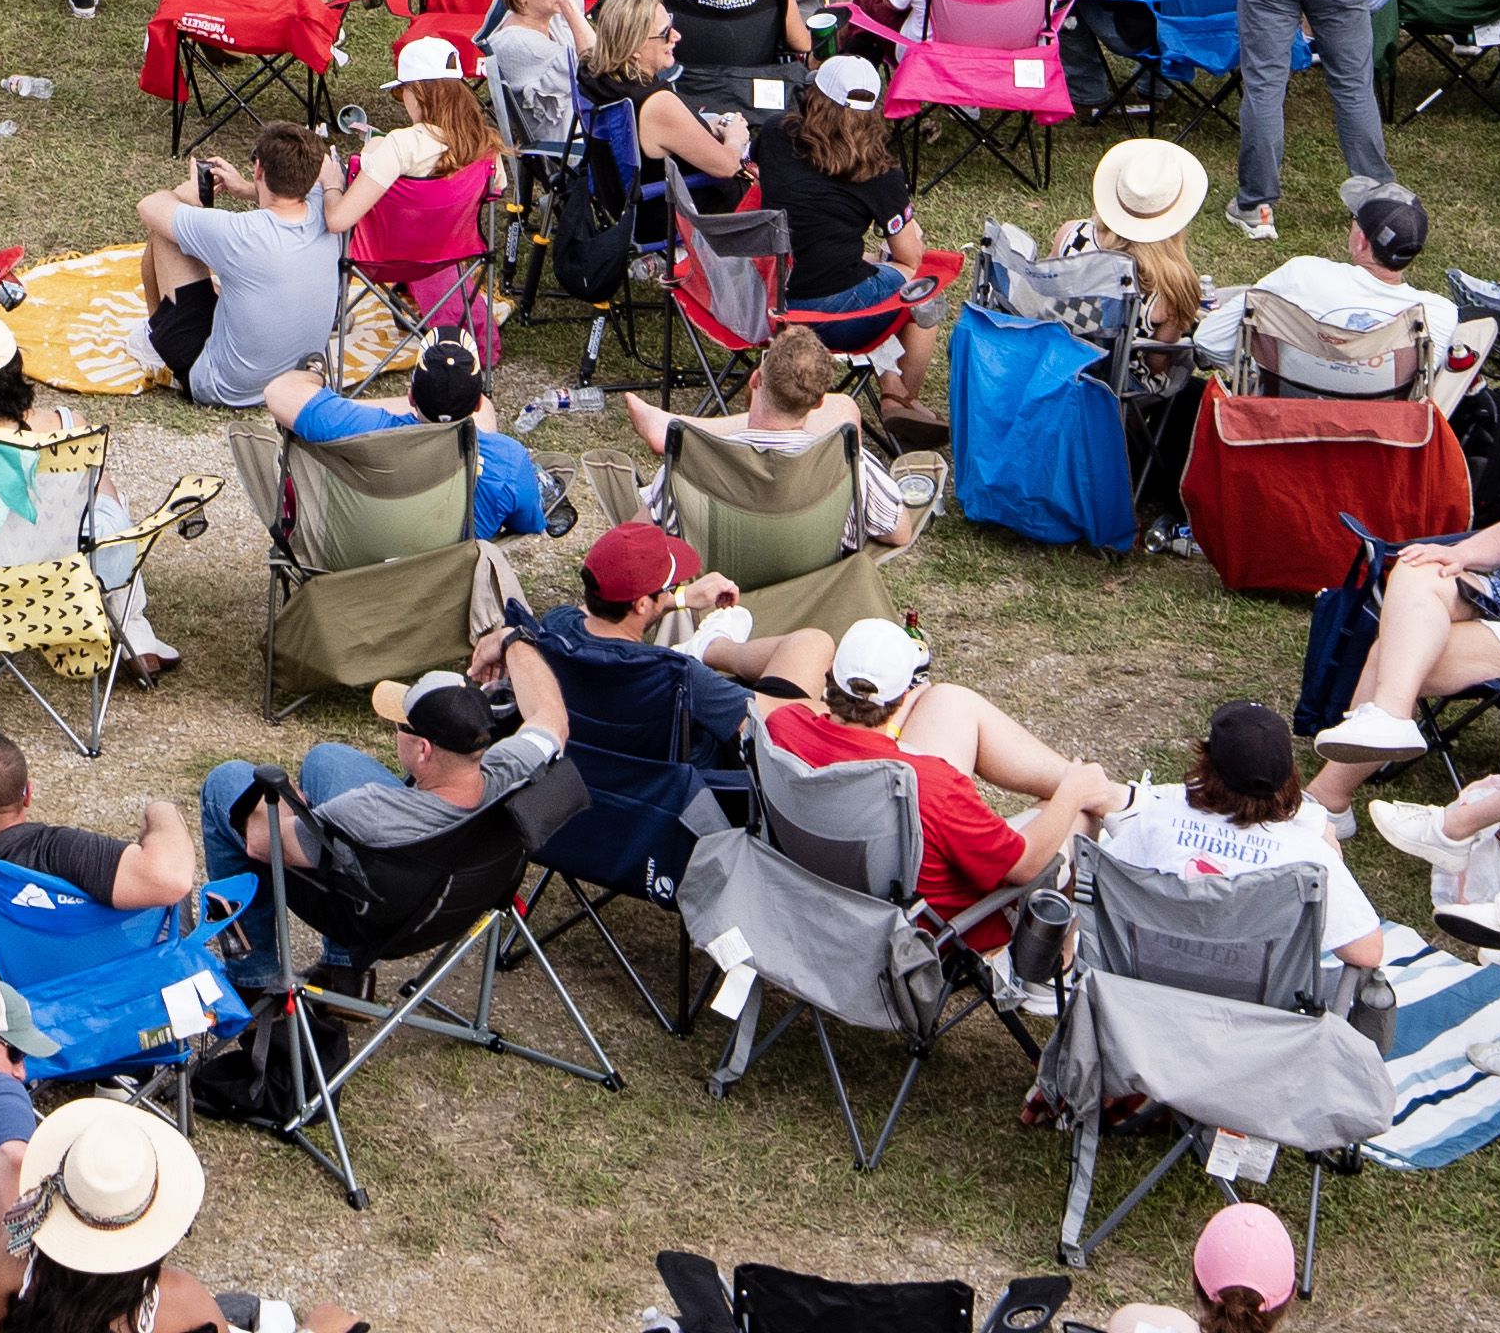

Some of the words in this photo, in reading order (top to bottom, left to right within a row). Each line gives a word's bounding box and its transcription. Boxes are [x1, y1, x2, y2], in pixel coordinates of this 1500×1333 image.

[1176, 830, 1270, 865] RUBBED
[1180, 818, 1212, 834] LIKE
[1216, 827, 1239, 841] MY
[1243, 833, 1285, 852] BUTT
